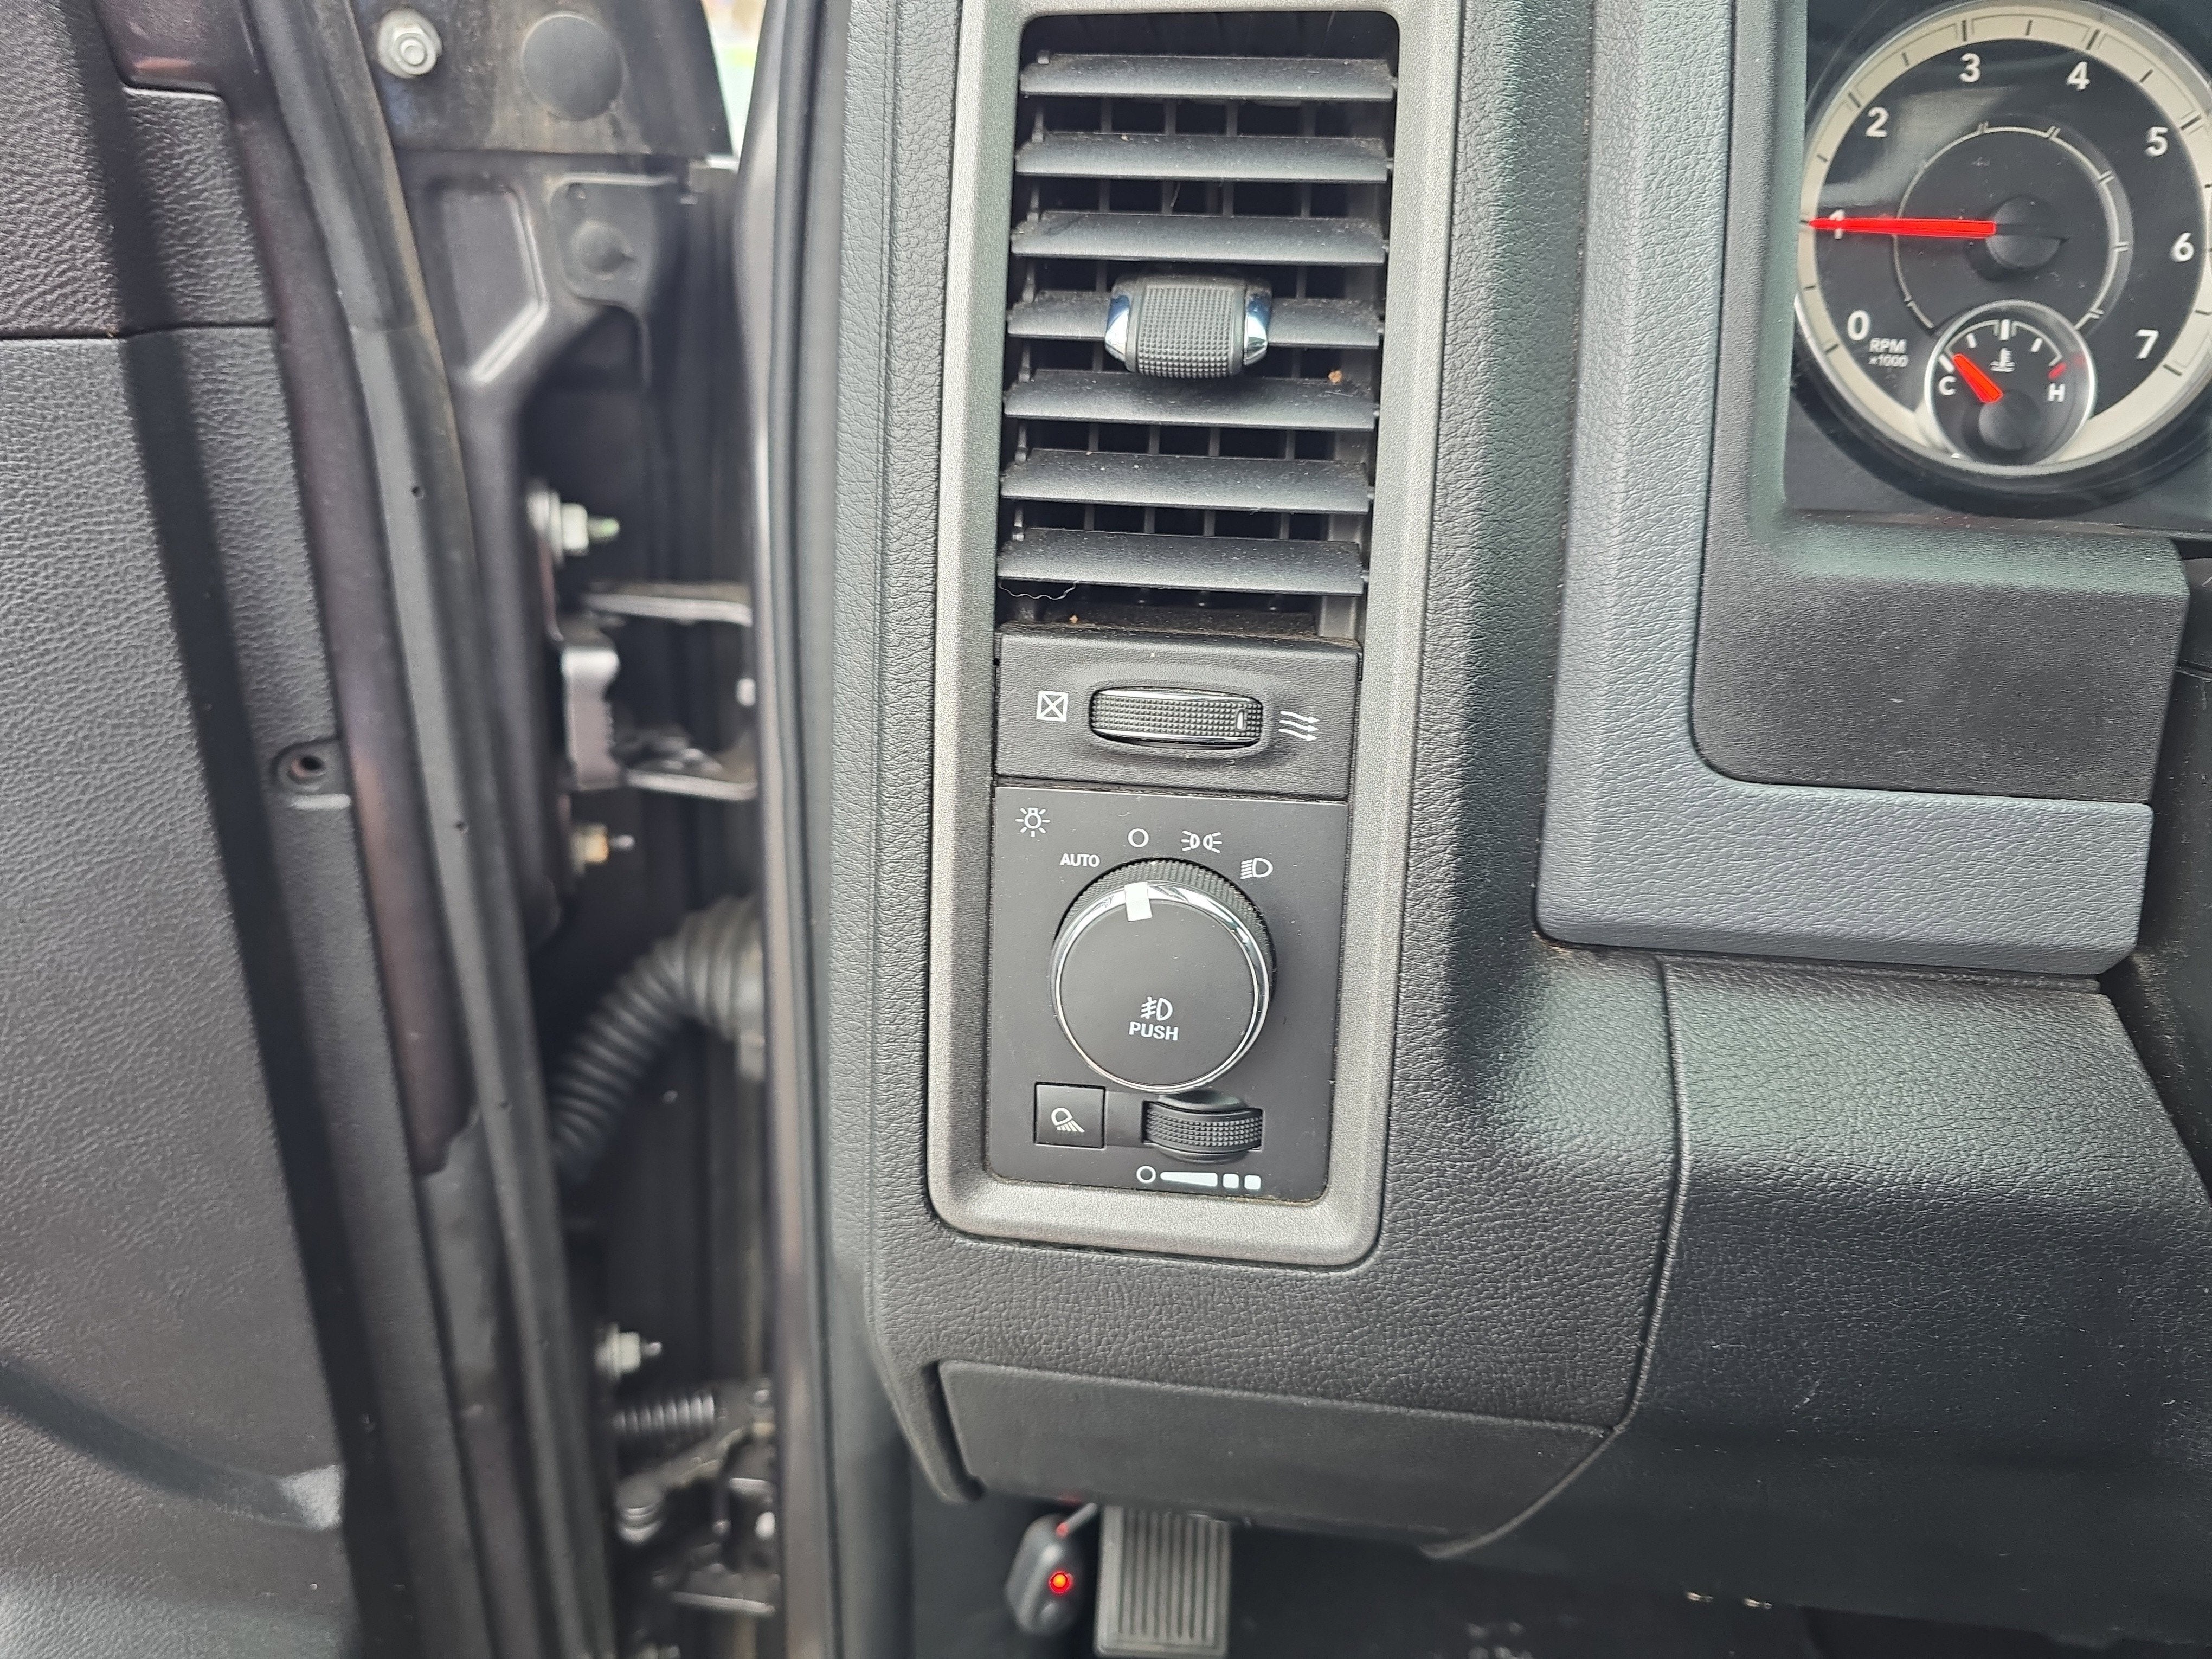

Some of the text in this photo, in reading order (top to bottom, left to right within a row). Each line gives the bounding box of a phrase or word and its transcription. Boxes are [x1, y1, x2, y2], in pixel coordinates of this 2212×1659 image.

[1959, 53, 1981, 83] 3
[2067, 61, 2091, 90] 4
[1866, 107, 1889, 138] 2
[2145, 126, 2169, 157] 5
[1829, 209, 1844, 239] 1
[2170, 232, 2195, 262] 6
[1847, 310, 1870, 340] 0
[1869, 338, 1907, 353] RPM
[2136, 329, 2159, 360] 7
[1939, 376, 1957, 396] C
[2047, 383, 2066, 402] H
[1059, 853, 1101, 867] AUTO
[1128, 1021, 1179, 1041] PUSH
